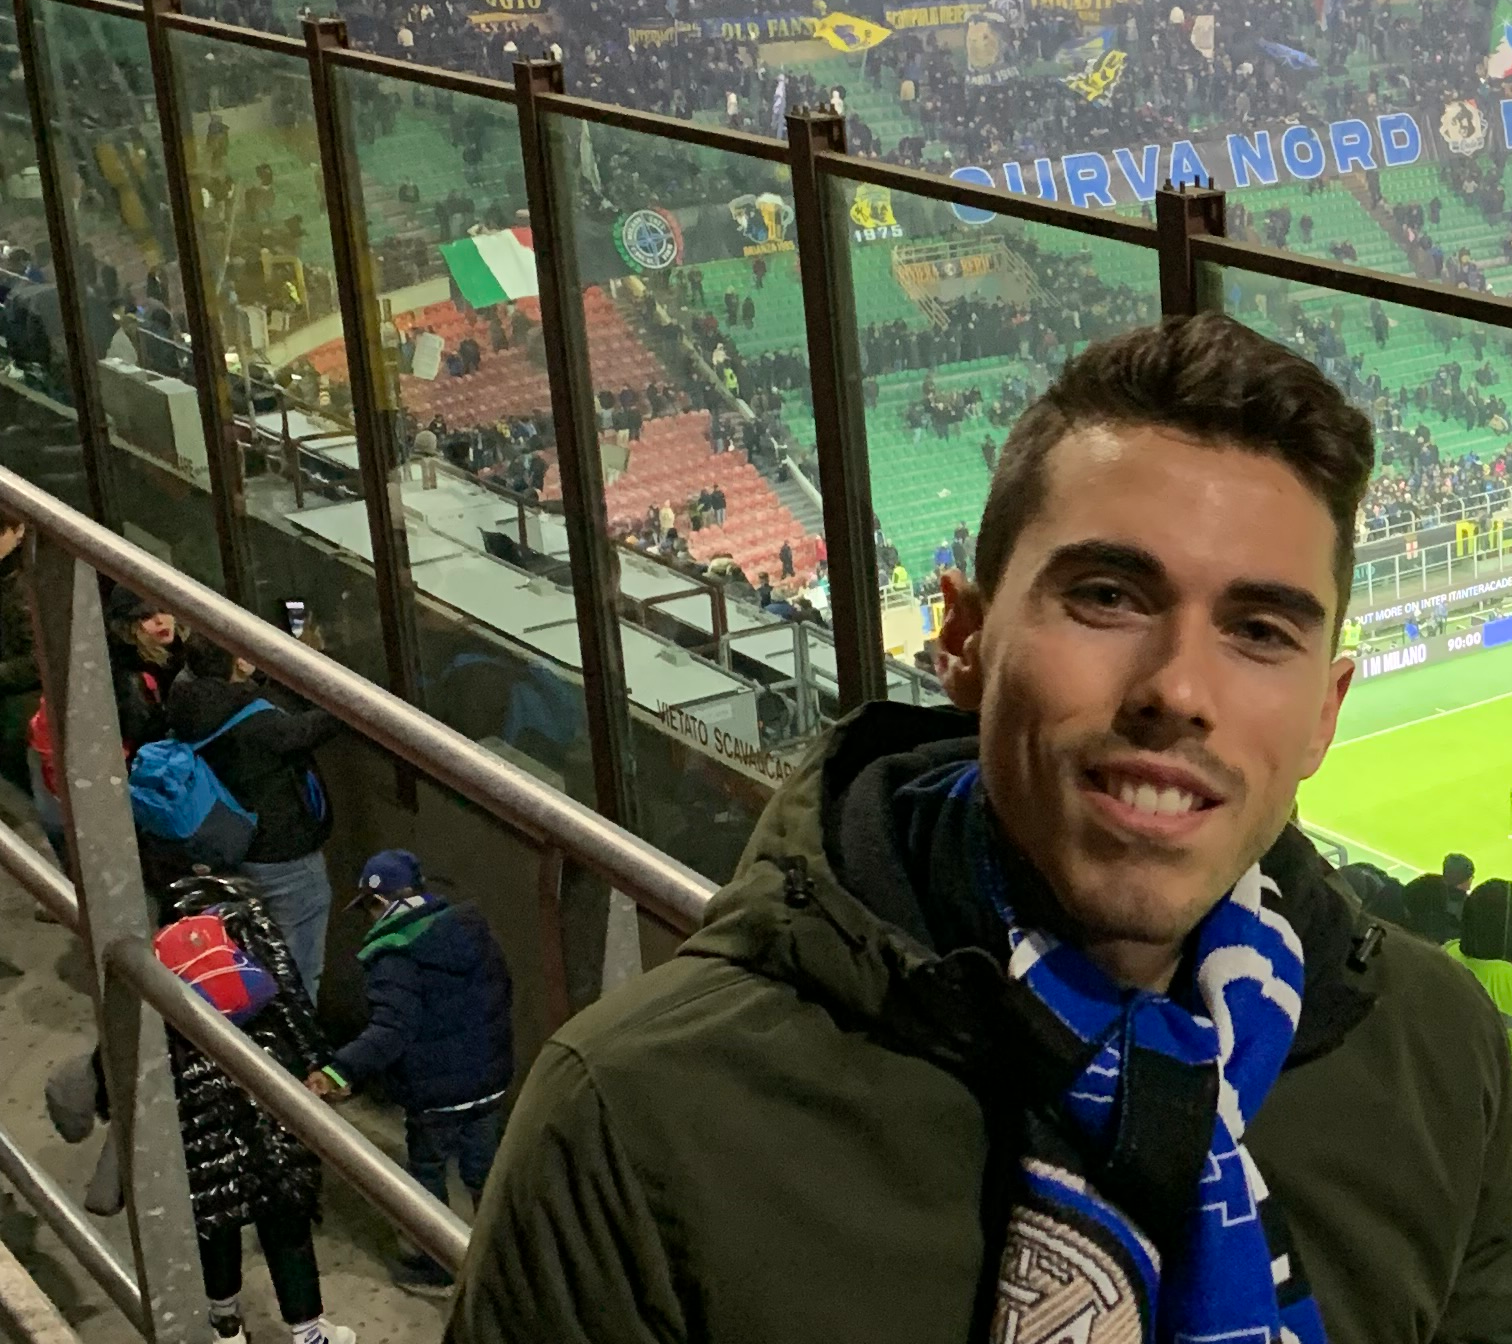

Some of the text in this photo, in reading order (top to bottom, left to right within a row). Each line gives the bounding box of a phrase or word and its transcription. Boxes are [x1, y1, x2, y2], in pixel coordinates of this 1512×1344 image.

[949, 140, 1209, 225] CURVA
[1227, 112, 1423, 187] NORD
[855, 224, 904, 243] 1975
[1375, 605, 1403, 621] MORE
[1404, 600, 1420, 614] ON
[1383, 643, 1427, 673] MILANO
[1447, 631, 1482, 652] 90:00
[656, 698, 797, 781] VIETATO SCAVALCAR
